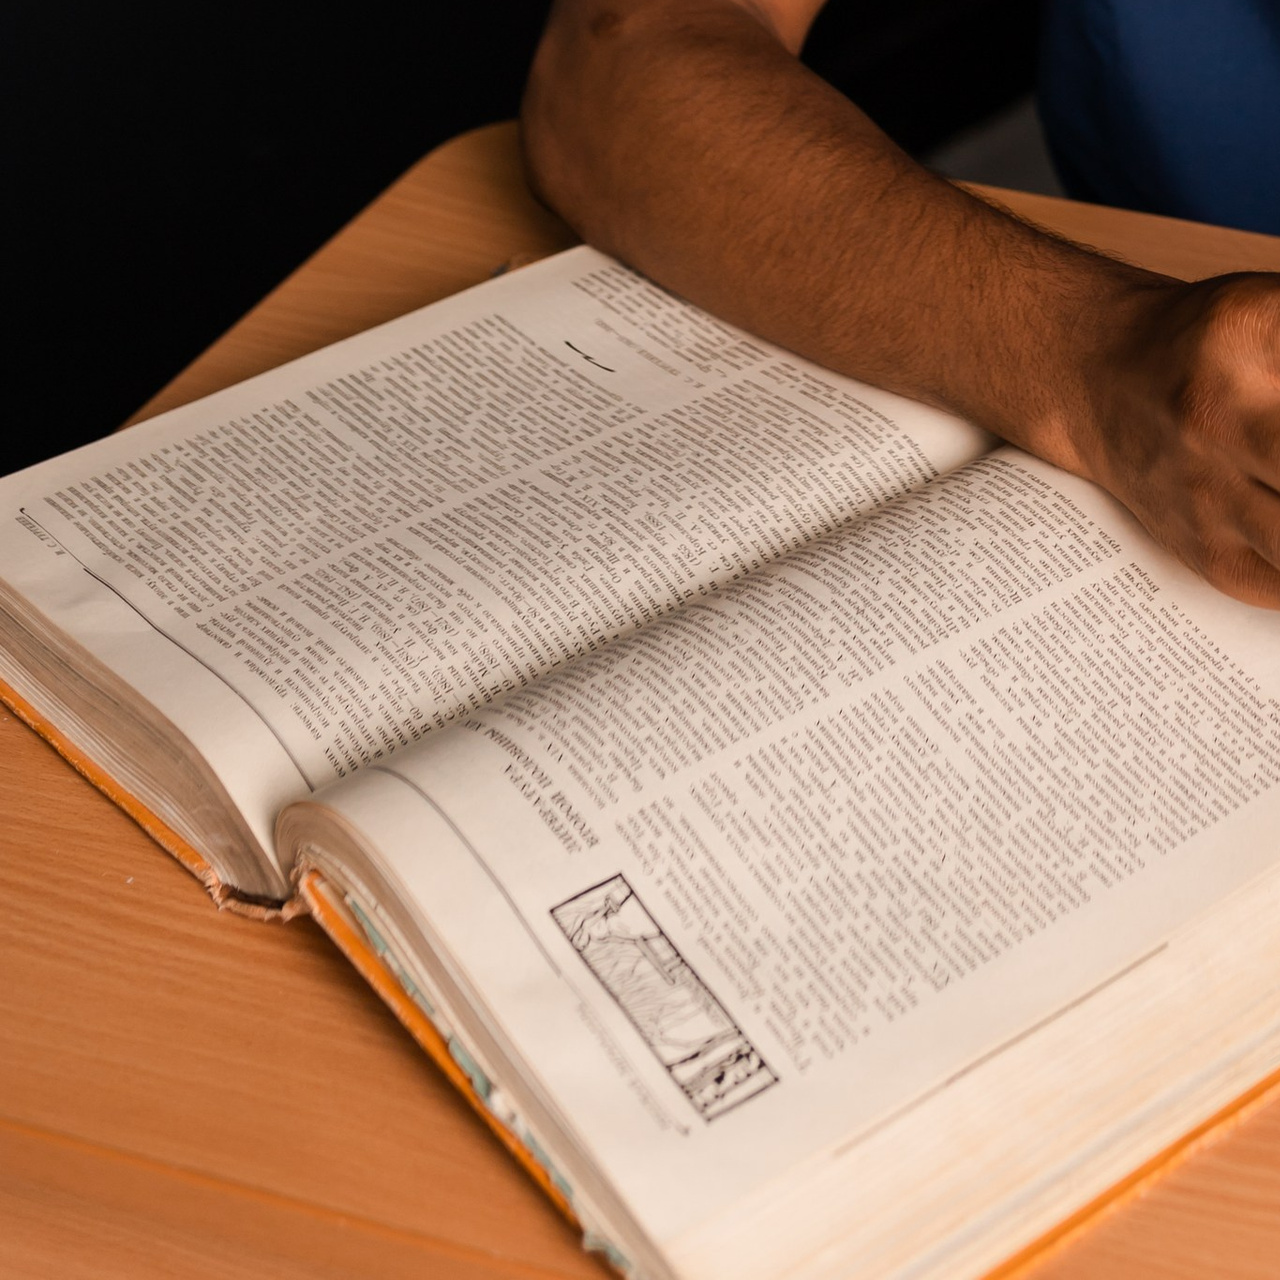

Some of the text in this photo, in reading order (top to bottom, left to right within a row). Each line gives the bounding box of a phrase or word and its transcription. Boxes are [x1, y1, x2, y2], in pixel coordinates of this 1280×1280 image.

[1052, 490, 1088, 519] которых
[924, 529, 960, 556] «Господа
[979, 508, 1063, 582] сокие гражданские
[1015, 500, 1093, 567] лачая угнетателей
[1051, 502, 1112, 558] ские писатели
[1066, 528, 1102, 563] жуазных
[974, 516, 1052, 586] характерные черты
[1032, 539, 1072, 578] бражения
[1052, 543, 1083, 572] новных
[957, 568, 987, 597] «Былое
[985, 565, 1022, 603] Щедрина
[1119, 567, 1154, 601] получил
[1129, 562, 1160, 593] Вторая
[901, 575, 959, 633] «Преступление
[920, 608, 949, 638] «Война
[1159, 607, 1179, 627] века
[485, 728, 551, 787] ПОЛОВИНЫ
[505, 764, 580, 851] ЛИТЕРАТУРА
[551, 791, 598, 847] ВТОРОЙ
